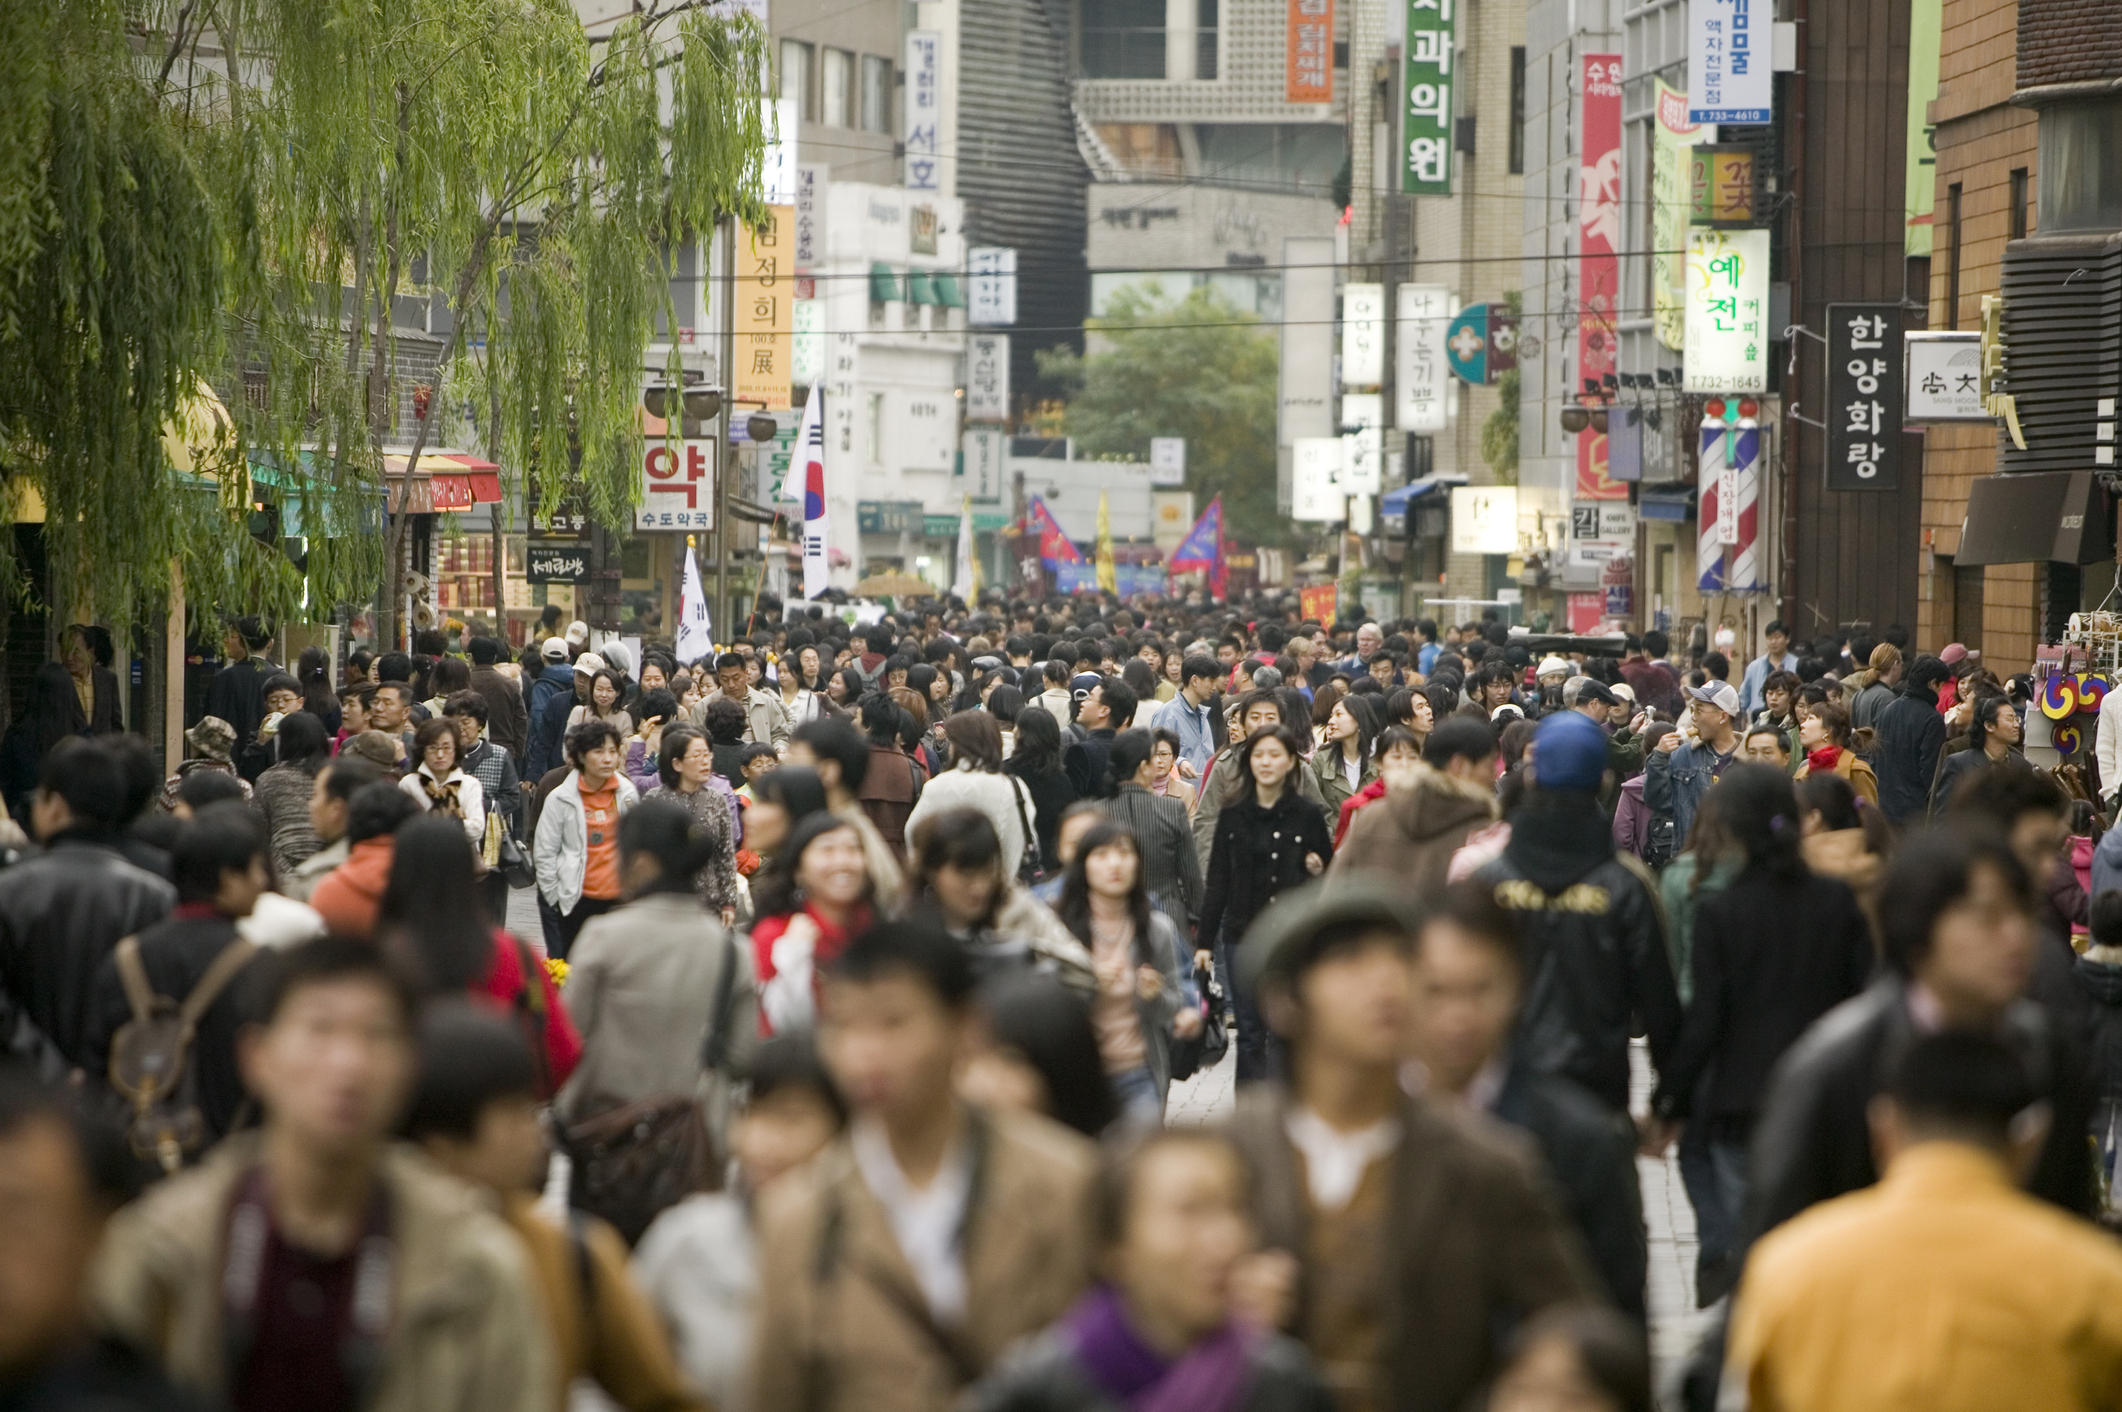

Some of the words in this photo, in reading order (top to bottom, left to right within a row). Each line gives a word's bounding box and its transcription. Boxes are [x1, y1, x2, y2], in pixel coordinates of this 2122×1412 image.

[1705, 19, 1723, 104] 액자전문점
[908, 123, 937, 189] 서호
[1706, 255, 1739, 331] 예전
[1742, 298, 1758, 361] 커피숍
[751, 350, 774, 375] 展
[1845, 315, 1888, 478] 한양화랑
[645, 445, 705, 509] 약
[642, 512, 707, 527] 수도약국
[1574, 509, 1597, 538] 칼
